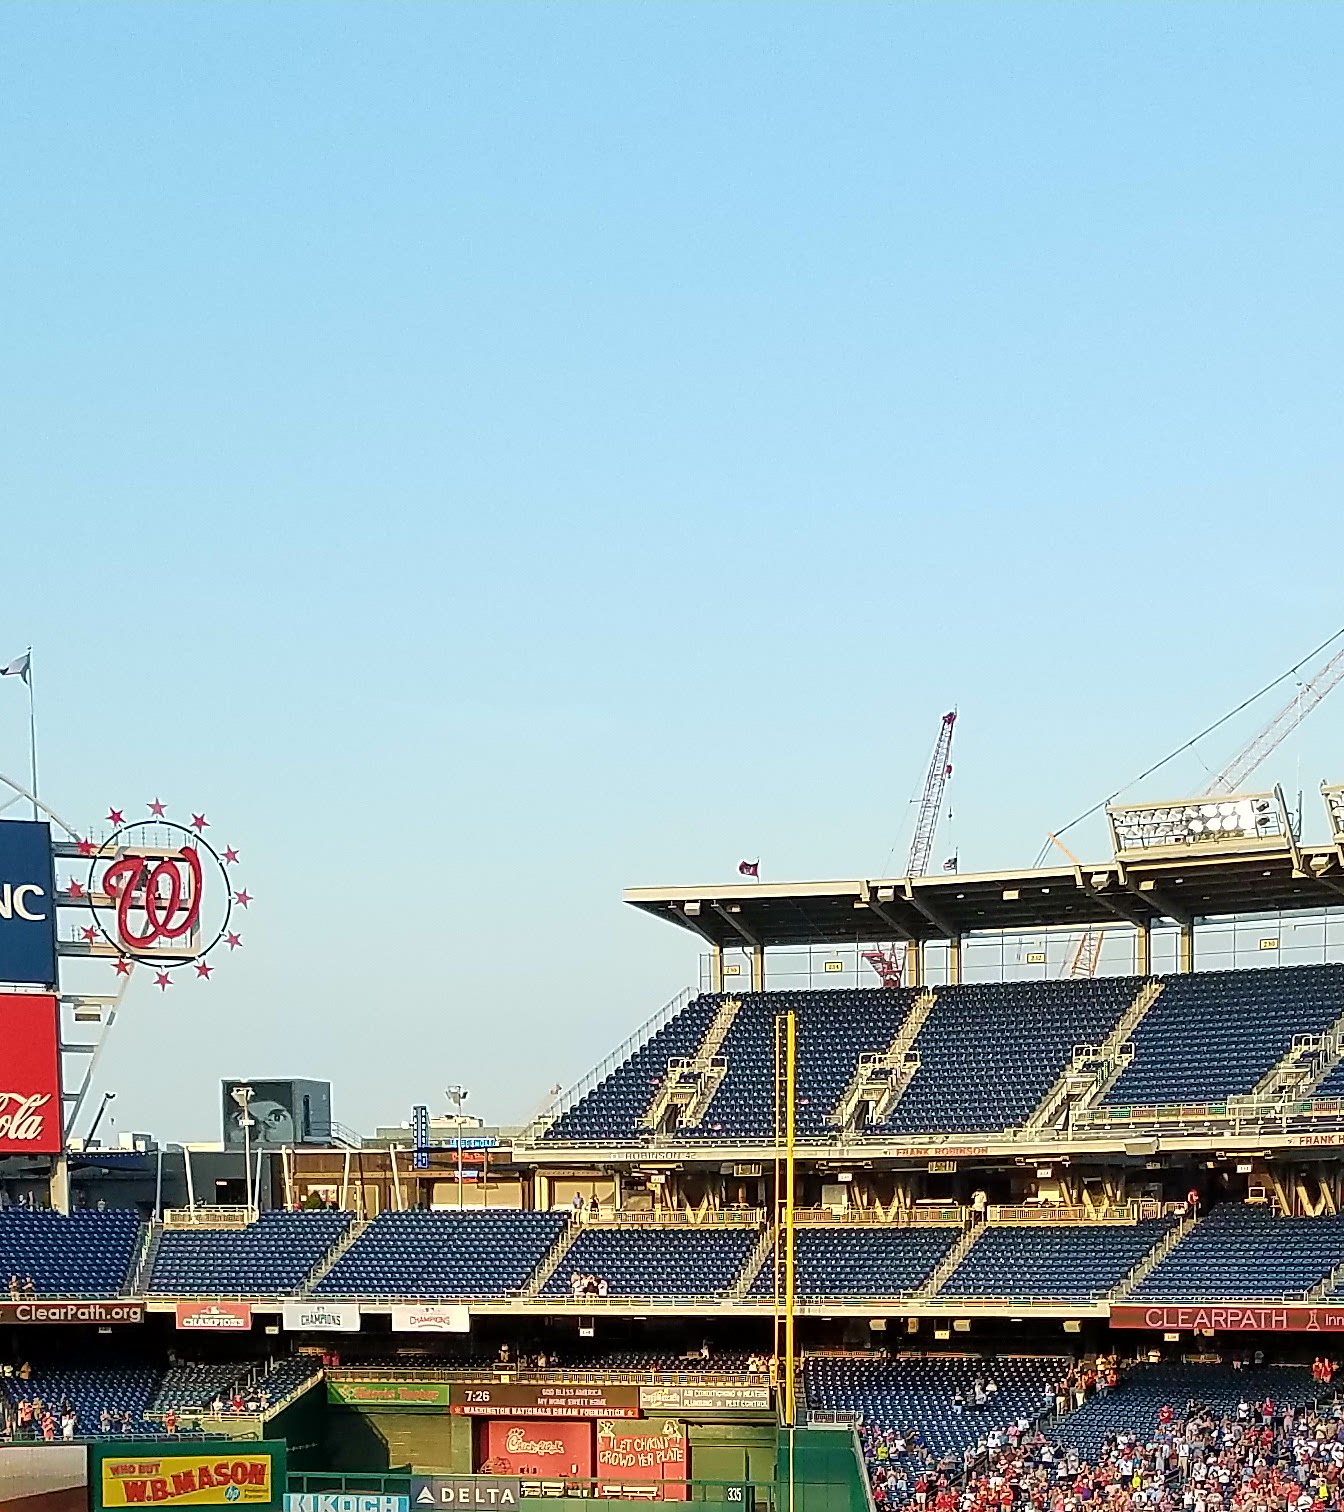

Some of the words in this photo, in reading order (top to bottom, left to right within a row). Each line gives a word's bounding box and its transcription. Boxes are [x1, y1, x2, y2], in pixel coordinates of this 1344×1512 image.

[1300, 1135, 1336, 1146] FRANK
[16, 1304, 142, 1323] ClearPath.org
[301, 1312, 341, 1326] CHAMPIONS
[410, 1315, 450, 1325] CHAMPIONS
[1145, 1308, 1288, 1329] CLEARPATH
[183, 1317, 244, 1328] CHAMPIONS
[464, 1390, 490, 1402] 7:26
[463, 1406, 510, 1416] WASHINGTON
[511, 1406, 551, 1416] NATIONALS
[614, 1439, 633, 1453] LET
[599, 1451, 636, 1467] CROWD
[637, 1453, 654, 1467] YER
[656, 1448, 685, 1464] PLATE
[110, 1463, 136, 1476] WHO
[138, 1463, 161, 1475] BUT
[441, 1487, 516, 1504] DELTA
[727, 1487, 742, 1502] 335
